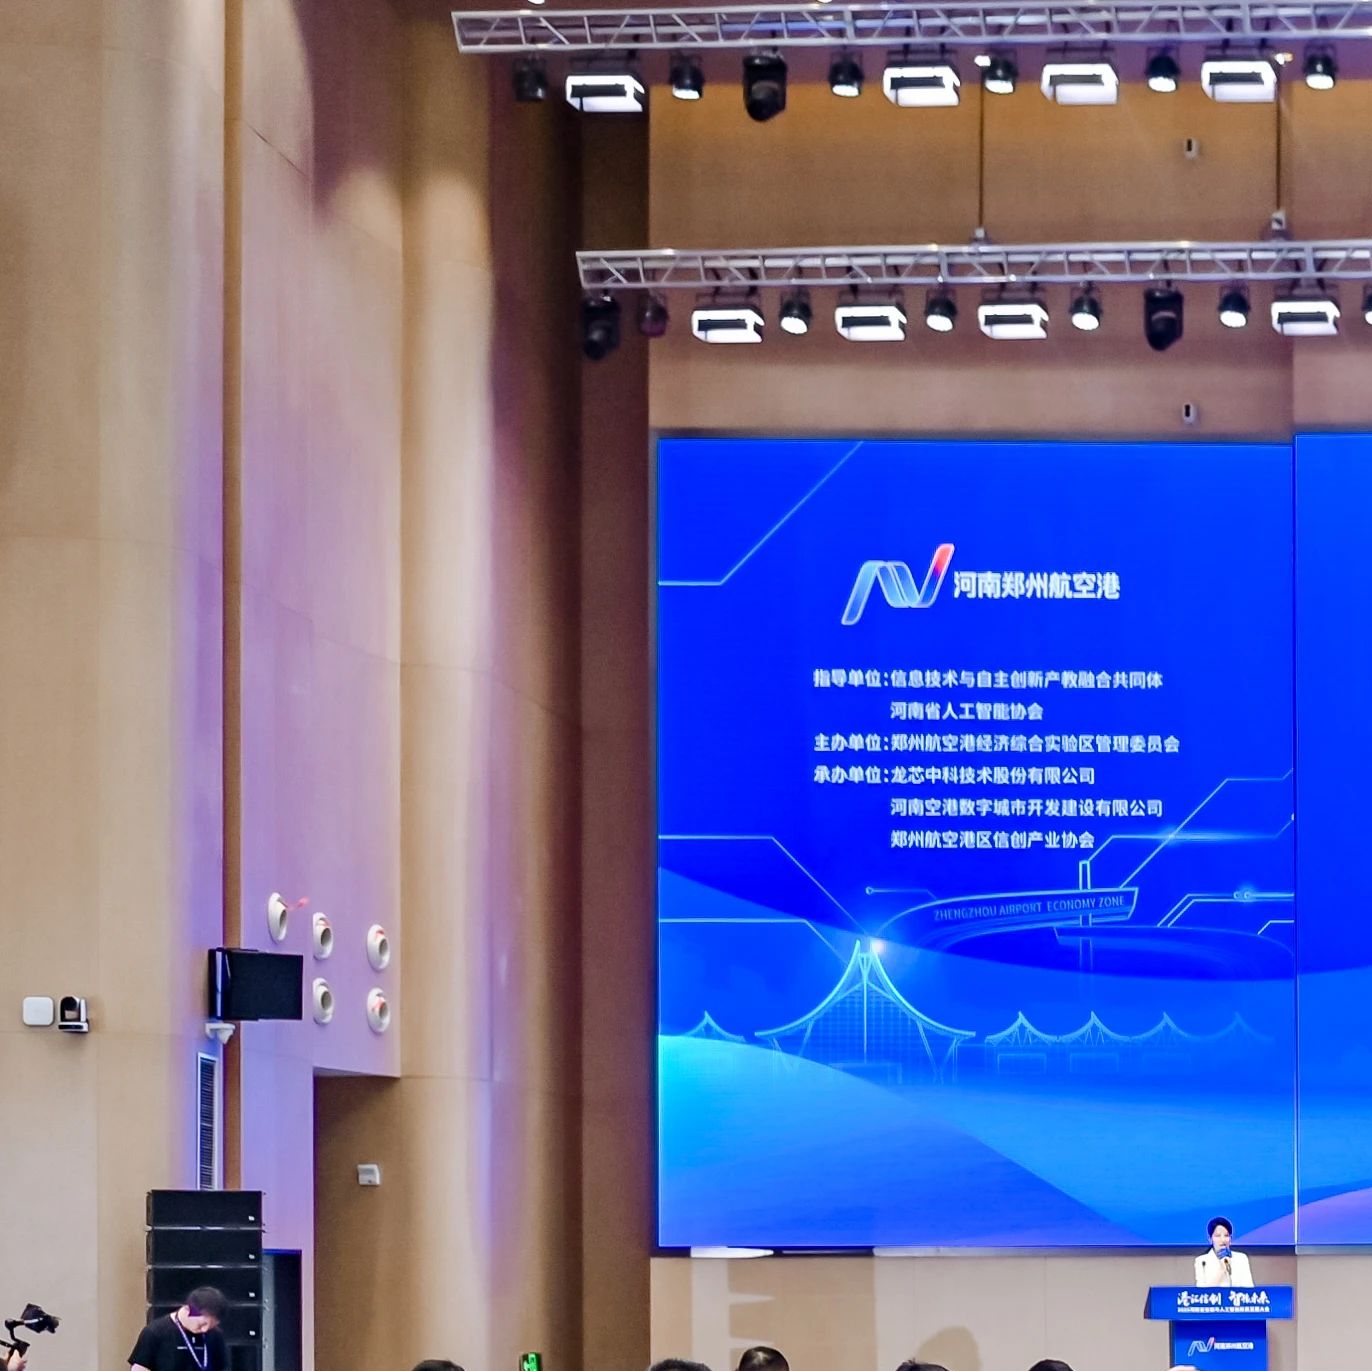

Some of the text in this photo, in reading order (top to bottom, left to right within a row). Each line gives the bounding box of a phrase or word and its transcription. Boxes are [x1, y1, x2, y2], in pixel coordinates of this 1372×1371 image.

[954, 571, 1120, 599] 河南郑州航空港
[891, 702, 1043, 720] 河南省人工智能协会
[814, 766, 1094, 784] 承办单位:龙芯中科技术股份有限公司
[891, 798, 1162, 817] 河南空港数字城市开发建设有限公司
[891, 830, 1095, 849] 郑州航空港区信创产业协会
[934, 895, 1124, 922] ZHENGZHOU AIRPORT ECONOMY ZONE
